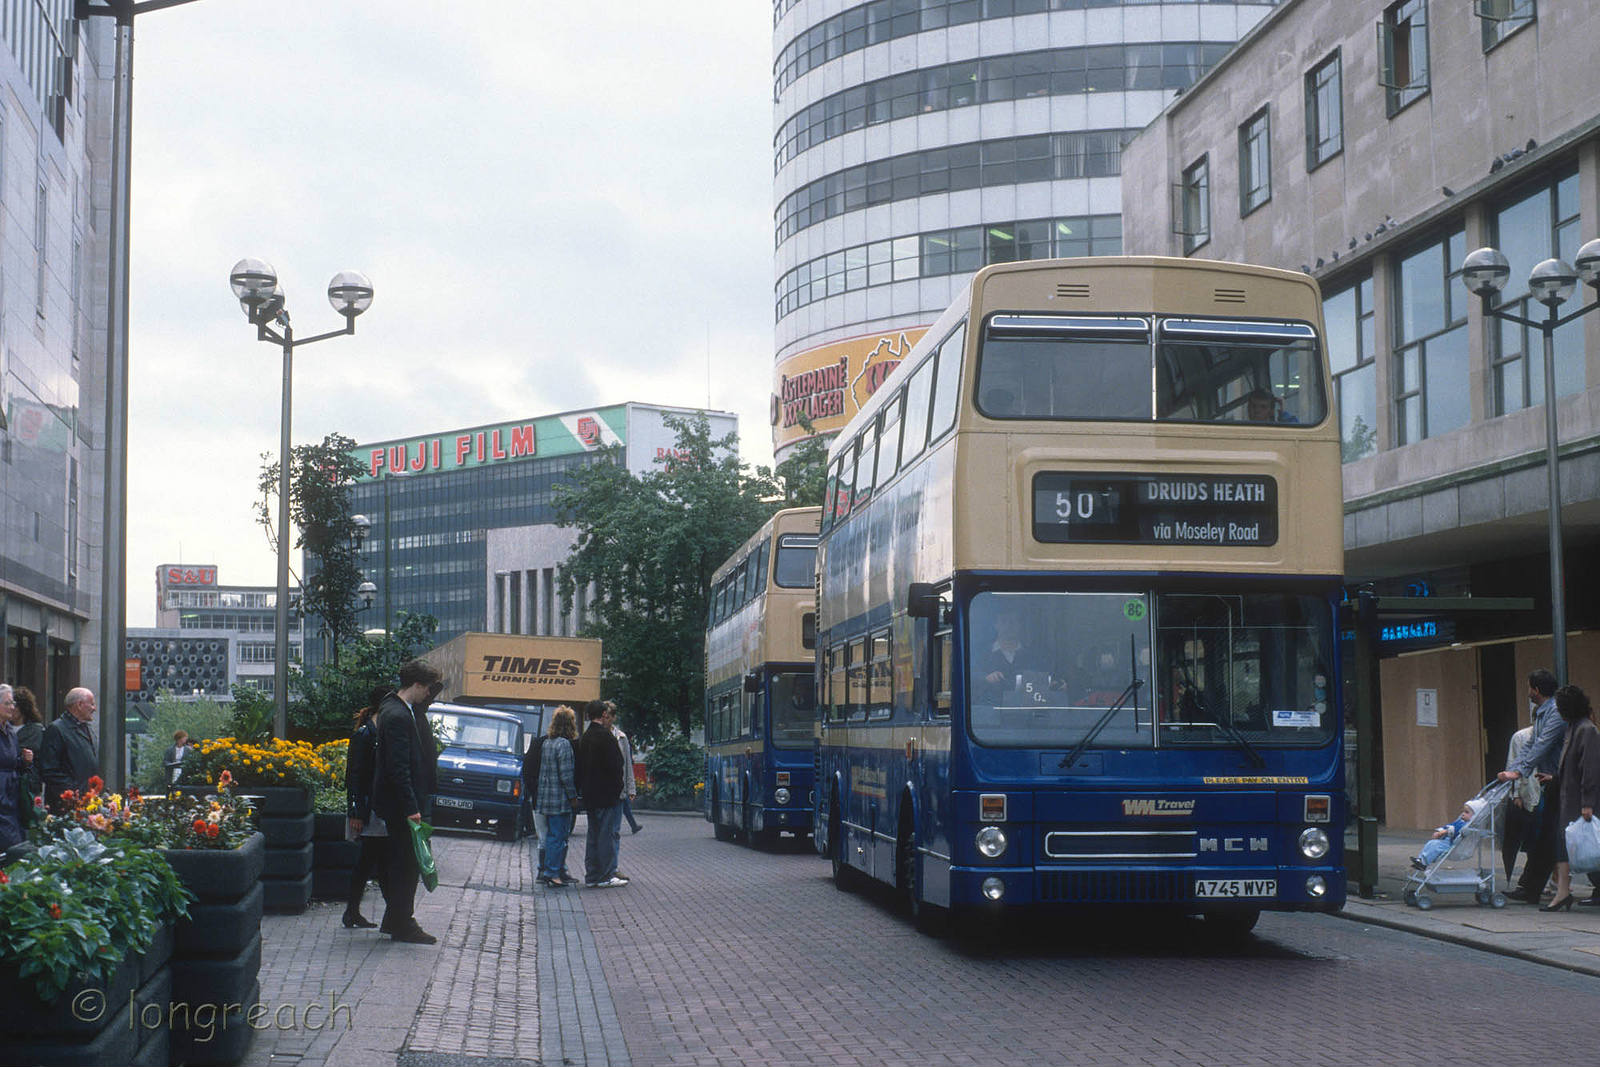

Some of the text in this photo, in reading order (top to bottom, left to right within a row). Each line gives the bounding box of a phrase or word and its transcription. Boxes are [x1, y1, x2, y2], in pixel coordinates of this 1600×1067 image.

[804, 390, 845, 420] LAGER
[370, 424, 535, 478] FUJI FILM
[1148, 482, 1265, 502] DRUIDS HEATH
[1056, 492, 1094, 519] 50
[1153, 521, 1259, 543] via Moseley Road
[168, 568, 215, 585] S&U
[483, 655, 581, 677] TIMES
[481, 674, 576, 686] FURNISHING
[1157, 799, 1196, 810] Travel
[1200, 837, 1269, 852] MCW
[1197, 880, 1276, 896] A745 WVP
